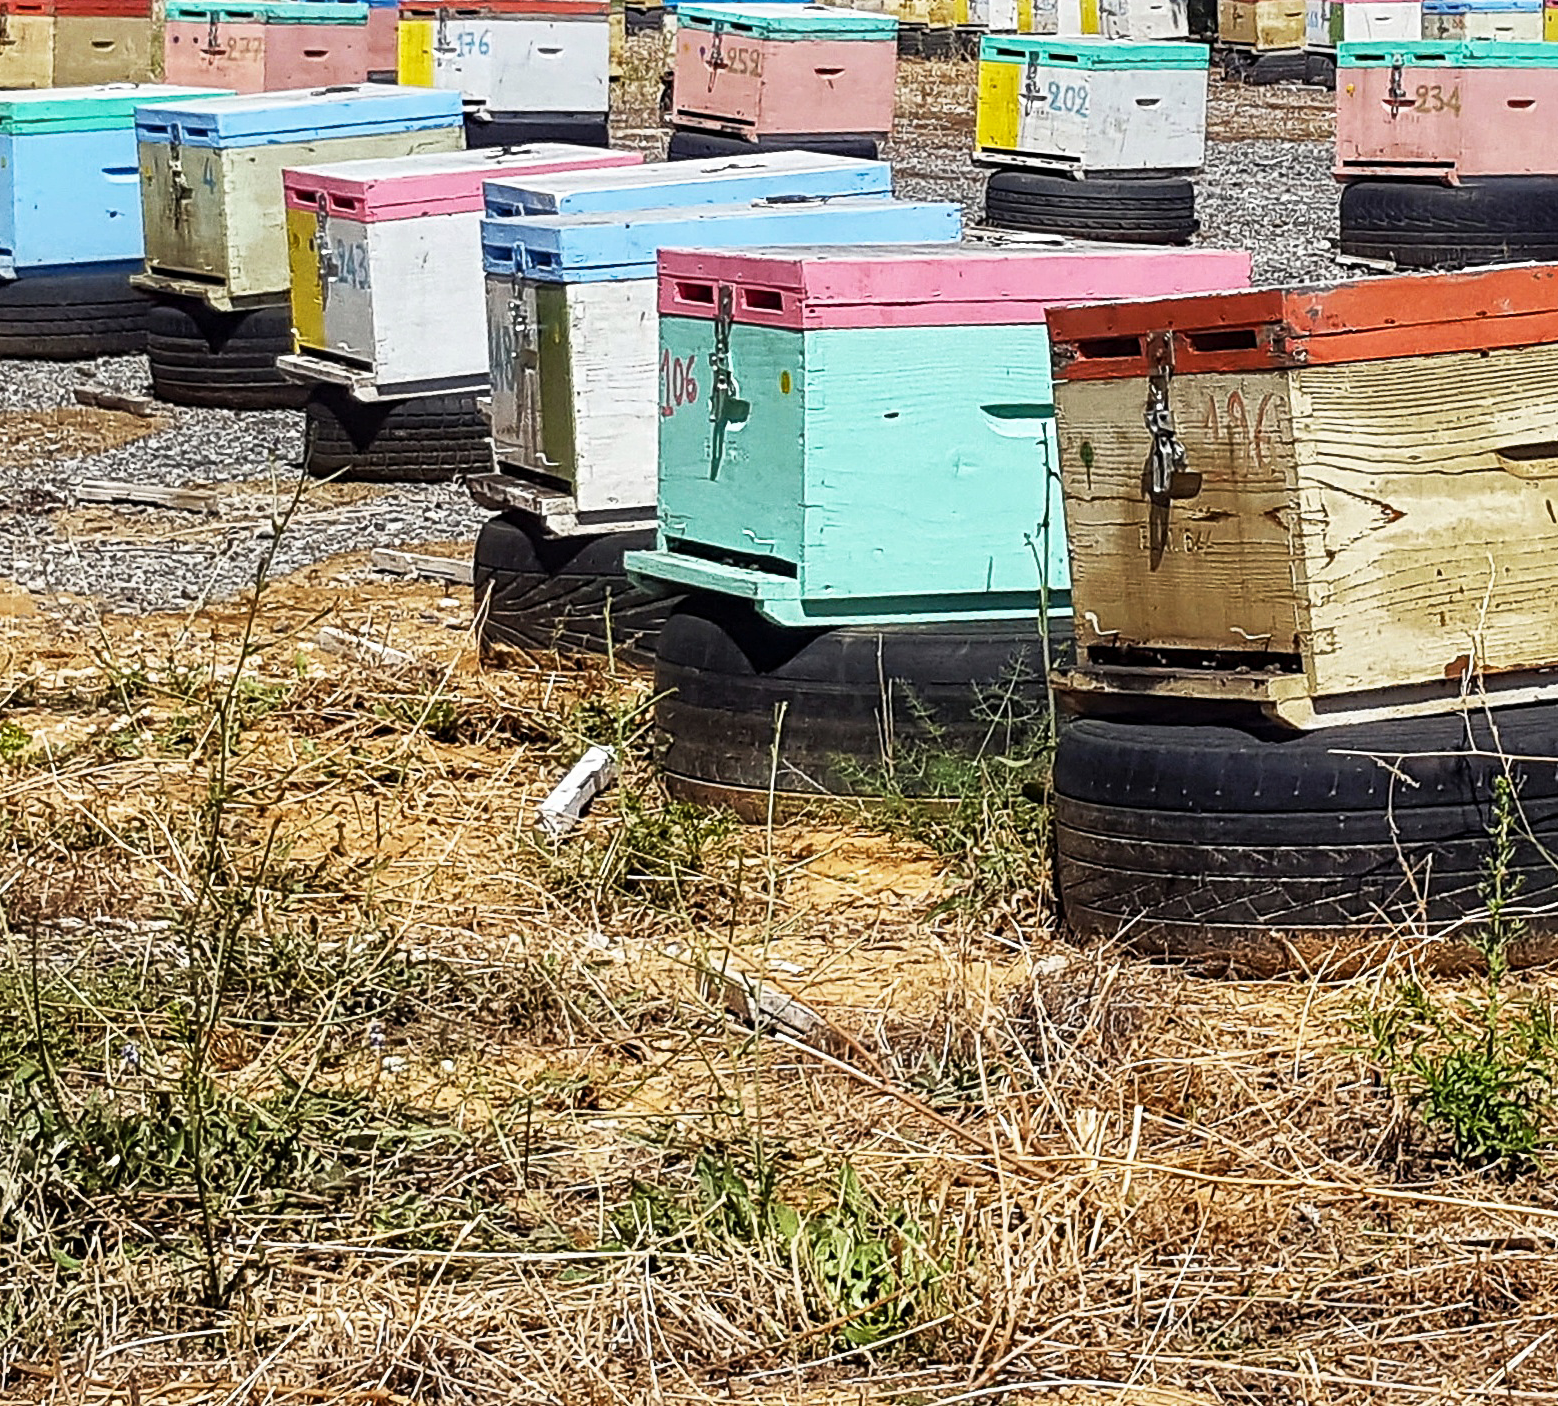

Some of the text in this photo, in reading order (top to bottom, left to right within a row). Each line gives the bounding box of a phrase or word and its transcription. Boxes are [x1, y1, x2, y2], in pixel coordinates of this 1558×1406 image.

[456, 27, 490, 57] 176
[727, 47, 762, 78] 252
[1047, 80, 1089, 118] 202
[1414, 84, 1462, 118] 234
[203, 156, 217, 196] 4
[336, 238, 369, 290] 243
[660, 347, 698, 417] 106
